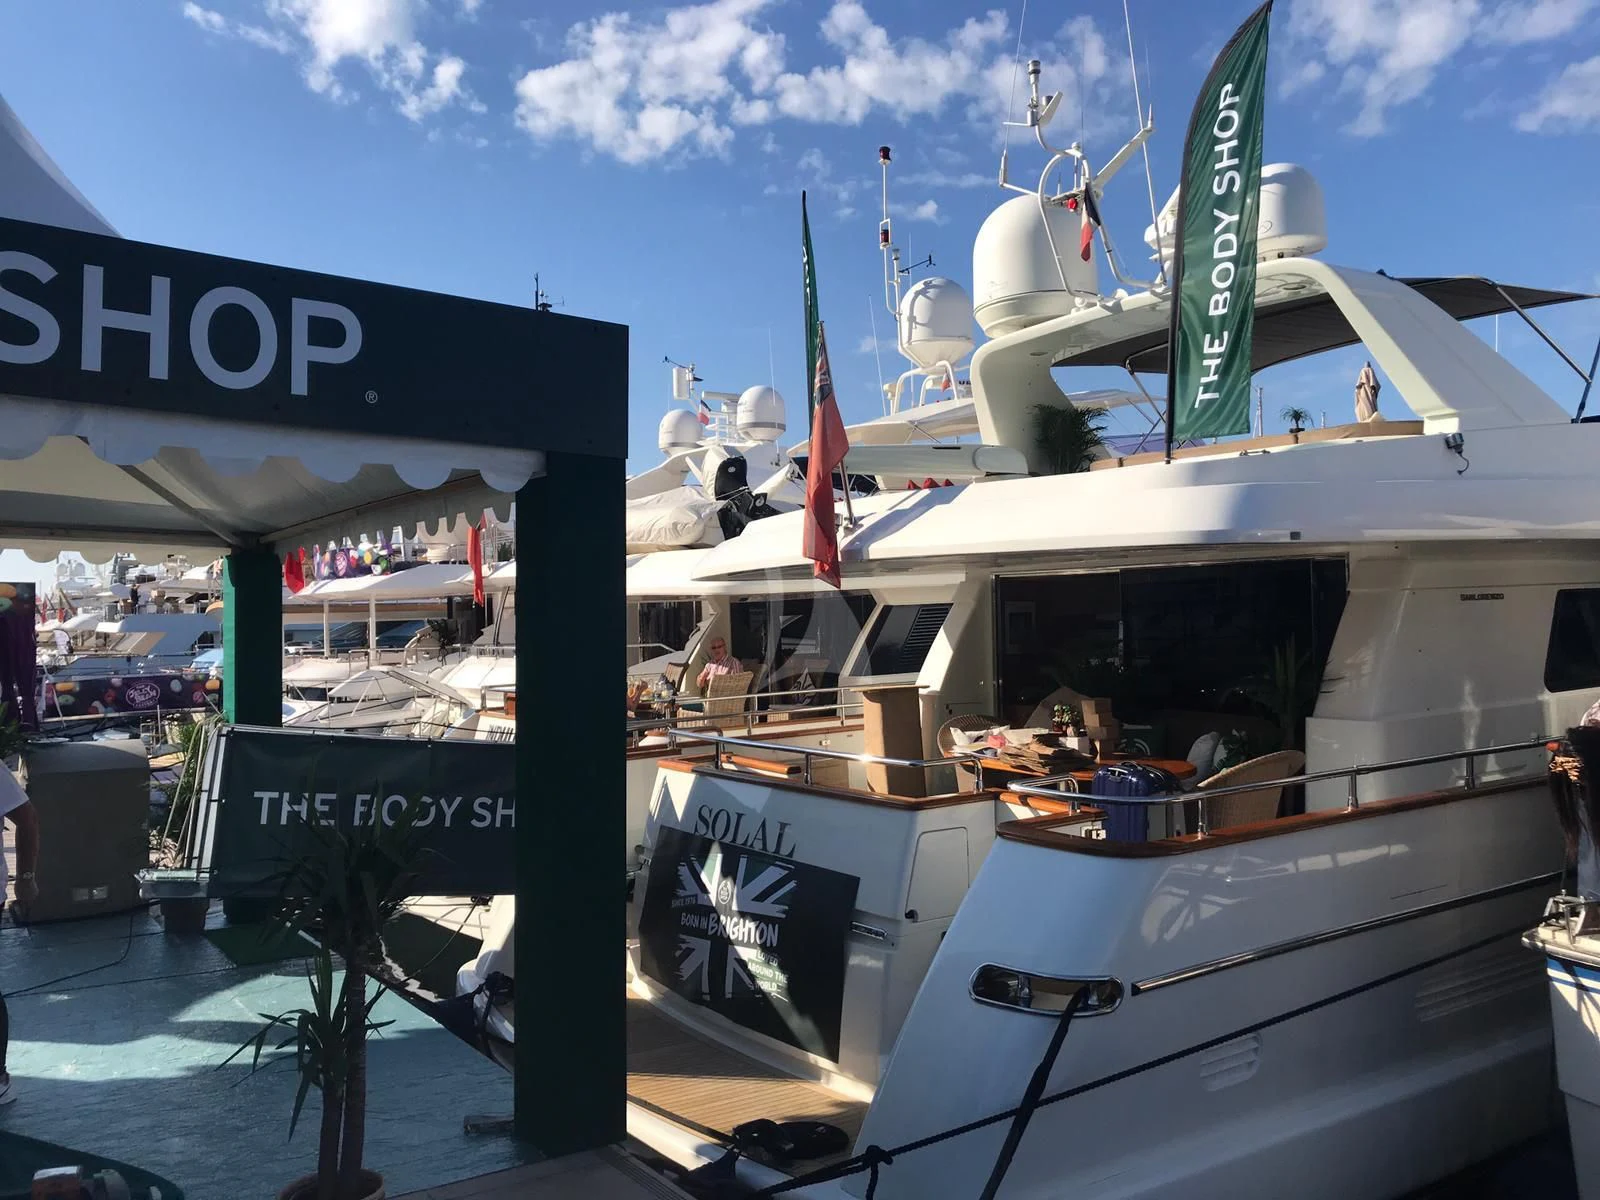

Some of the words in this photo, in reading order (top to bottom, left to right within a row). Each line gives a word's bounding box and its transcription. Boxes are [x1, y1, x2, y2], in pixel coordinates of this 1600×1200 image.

[1212, 83, 1241, 196] SHOP
[1208, 207, 1240, 317] BODY
[0, 249, 362, 396] SHOP
[1195, 330, 1229, 410] THE
[253, 791, 337, 826] THE
[695, 803, 796, 858] SOLAL
[680, 912, 699, 929] BORN
[700, 915, 707, 929] IN
[707, 912, 778, 947] BRIGHTON
[747, 962, 773, 978] AROUND
[775, 971, 789, 983] THE
[757, 949, 778, 967] LOVED
